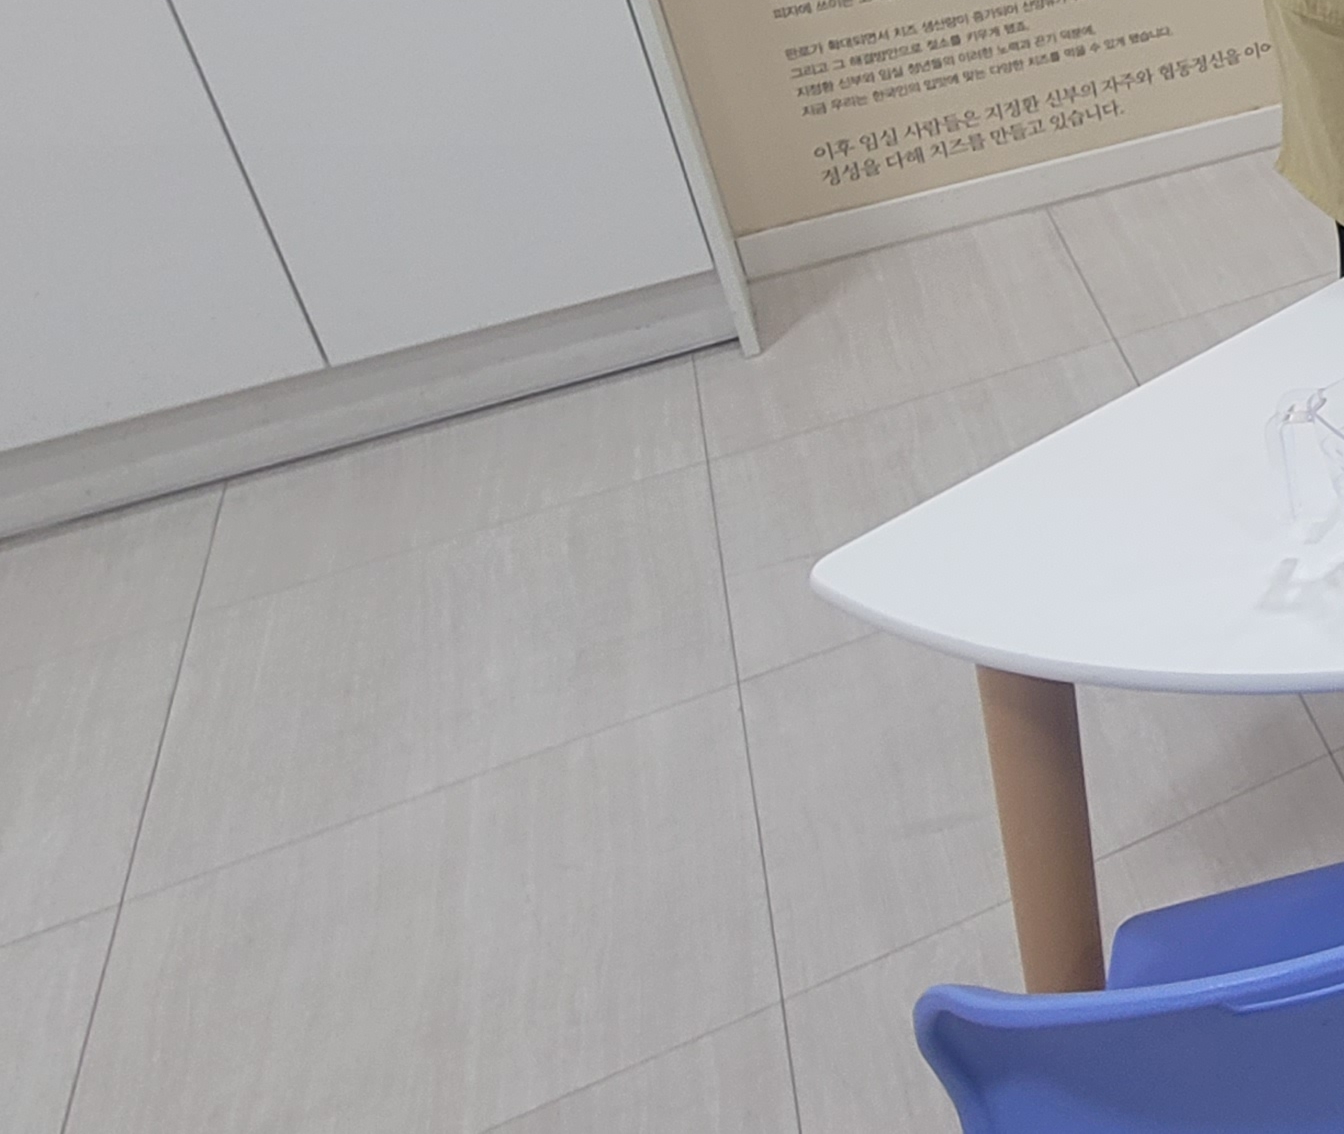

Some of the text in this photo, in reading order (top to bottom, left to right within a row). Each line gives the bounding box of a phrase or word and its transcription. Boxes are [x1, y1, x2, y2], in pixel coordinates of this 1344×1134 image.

[813, 48, 1240, 161] 이후 임실 사람들은 지정환 신부의 자주와 협동정신을
[821, 98, 1125, 186] 정성을 다해 치즈를 만들고 있습니다.
